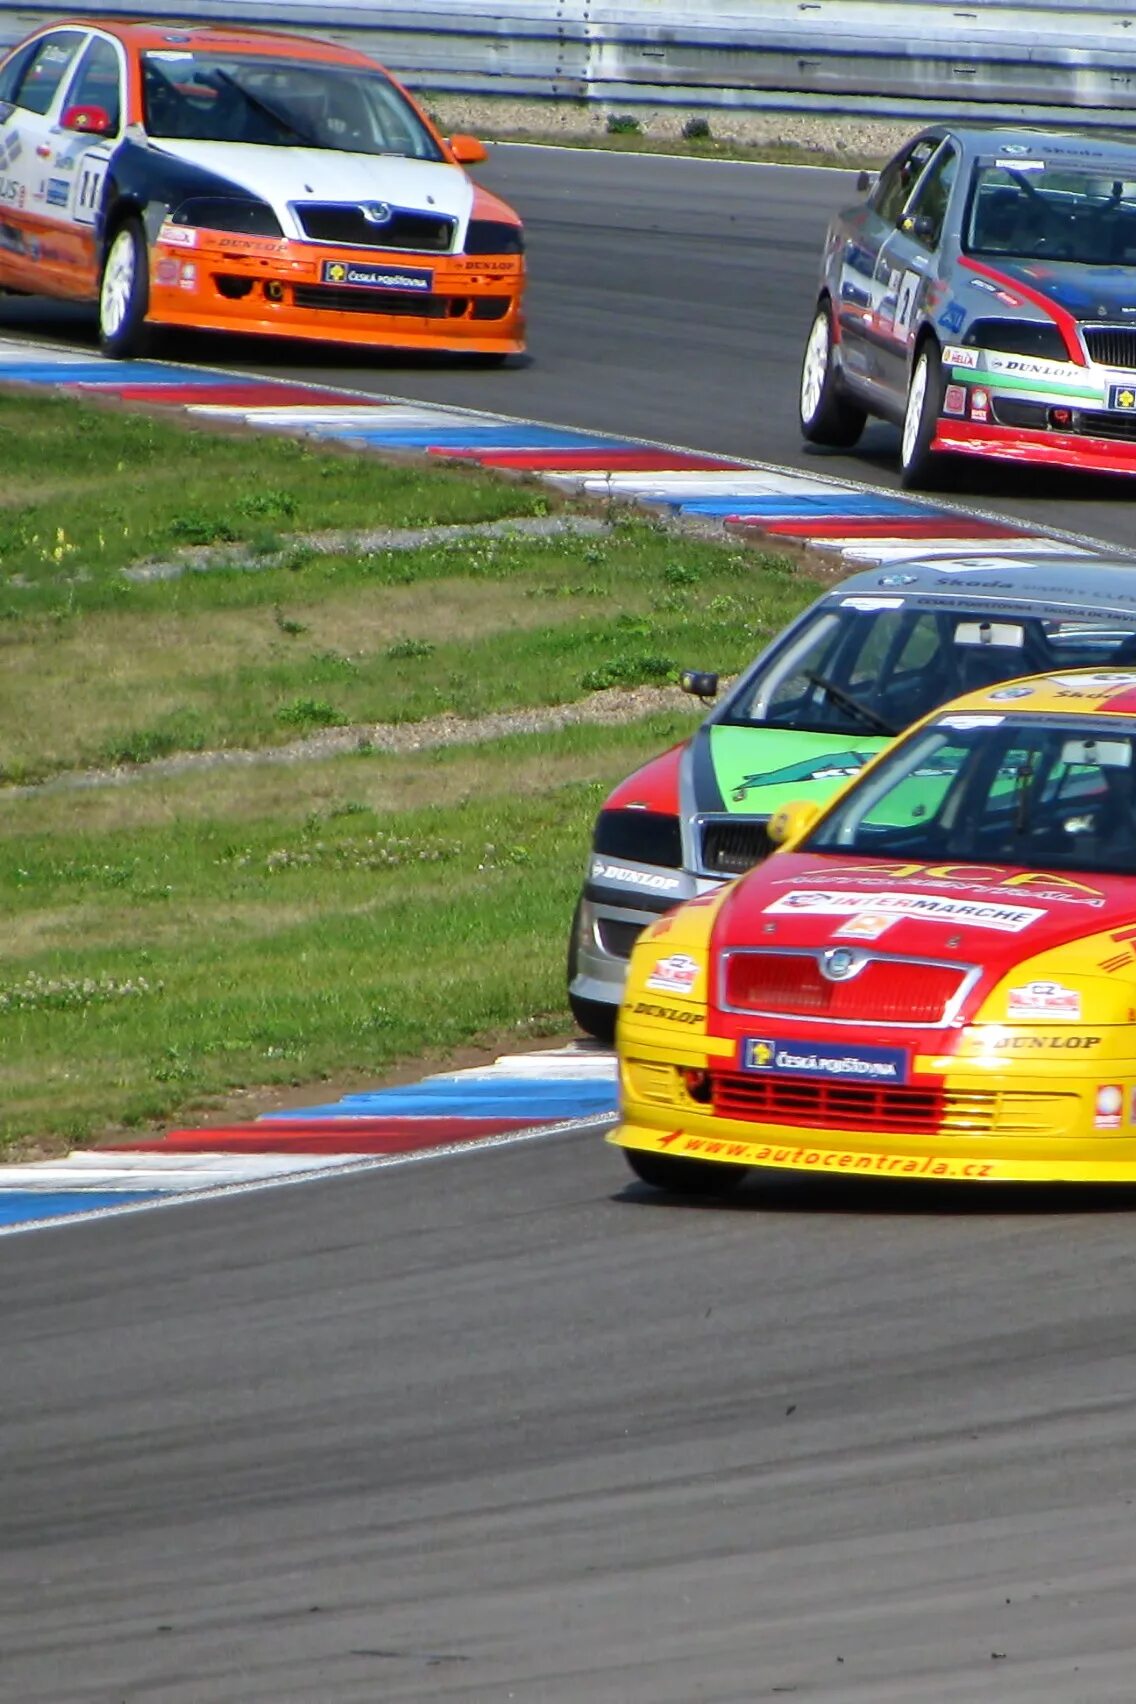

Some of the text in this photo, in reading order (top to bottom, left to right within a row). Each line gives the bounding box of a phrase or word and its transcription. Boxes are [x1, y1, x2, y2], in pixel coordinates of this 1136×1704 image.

[79, 169, 101, 209] 11
[218, 238, 289, 252] DUNLOP
[465, 261, 514, 270] DUNLOP
[1005, 360, 1079, 378] DUNLOP
[604, 865, 680, 890] DUNLOP
[802, 863, 1104, 897] ACA
[833, 894, 1034, 923] INTERMARCHE
[1031, 984, 1055, 996] CZ
[633, 1002, 705, 1026] DUNLOP
[993, 1035, 1102, 1049] DUNLOP
[776, 1050, 816, 1068] ČESKÁ
[684, 1136, 996, 1178] www.autocentrala.cz
